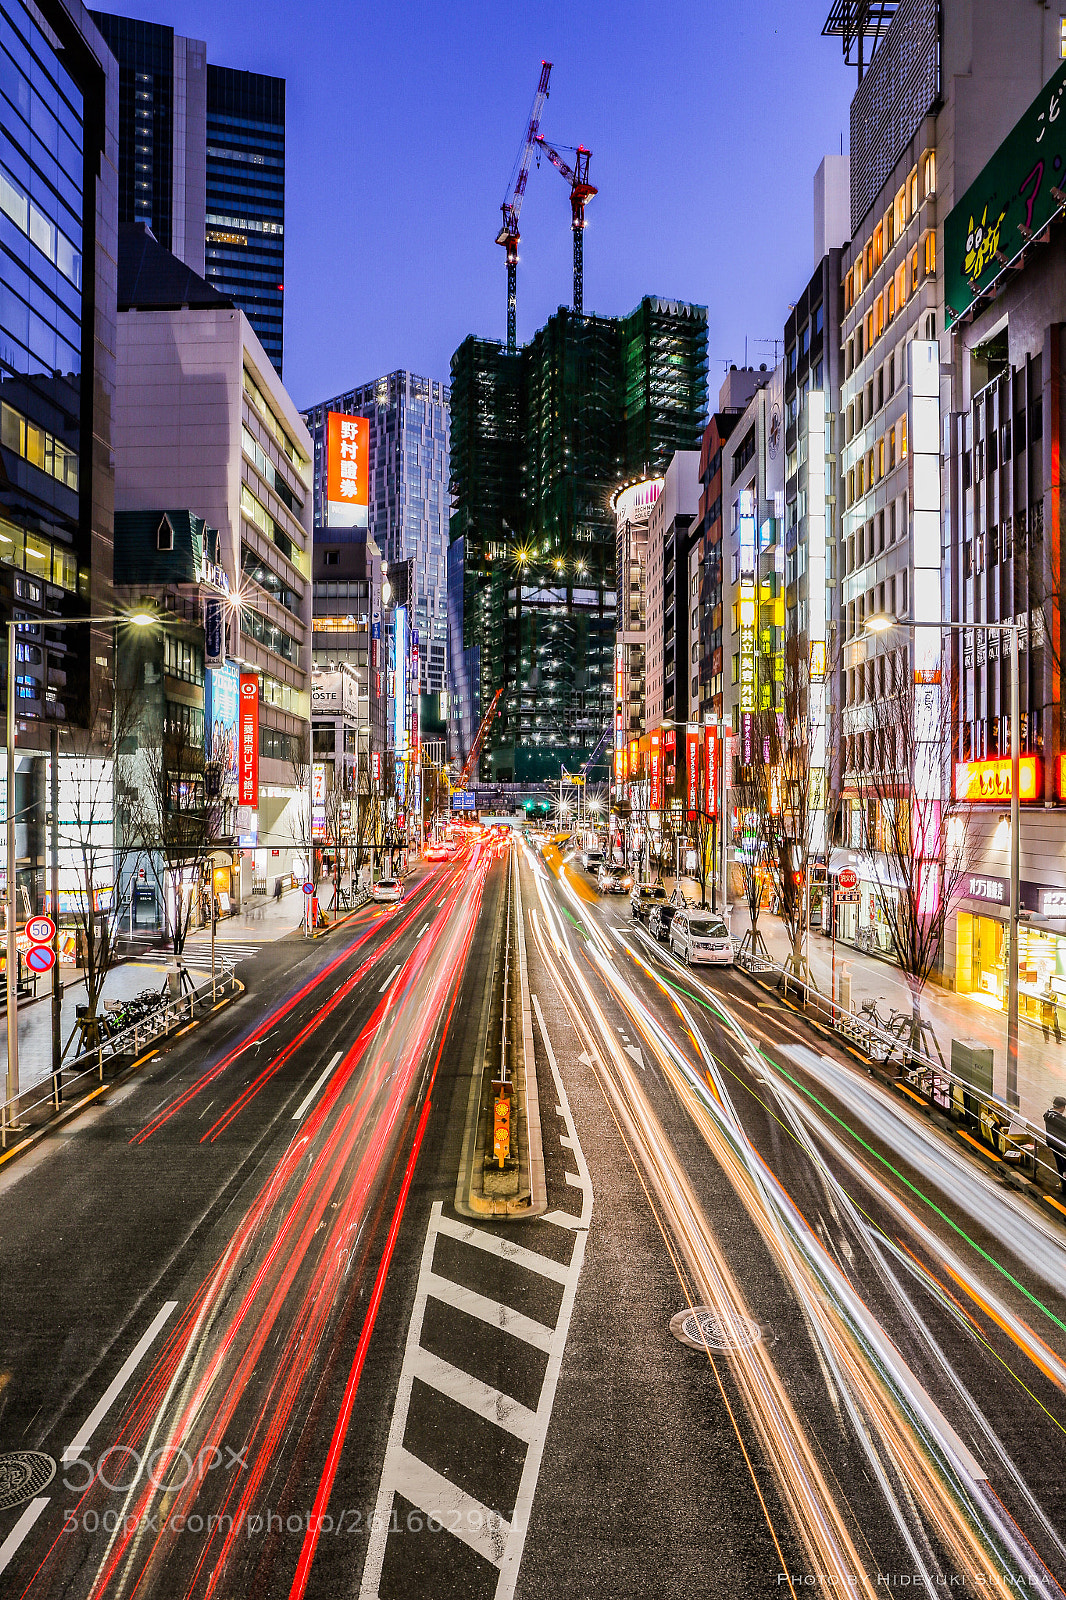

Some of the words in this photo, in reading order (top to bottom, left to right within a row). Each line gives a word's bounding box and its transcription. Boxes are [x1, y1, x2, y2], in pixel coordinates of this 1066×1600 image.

[340, 420, 359, 498] 野村證券
[741, 629, 754, 707] 共立美容外科
[243, 714, 254, 800] 三菱東京UFJ銀行
[32, 924, 49, 936] 50
